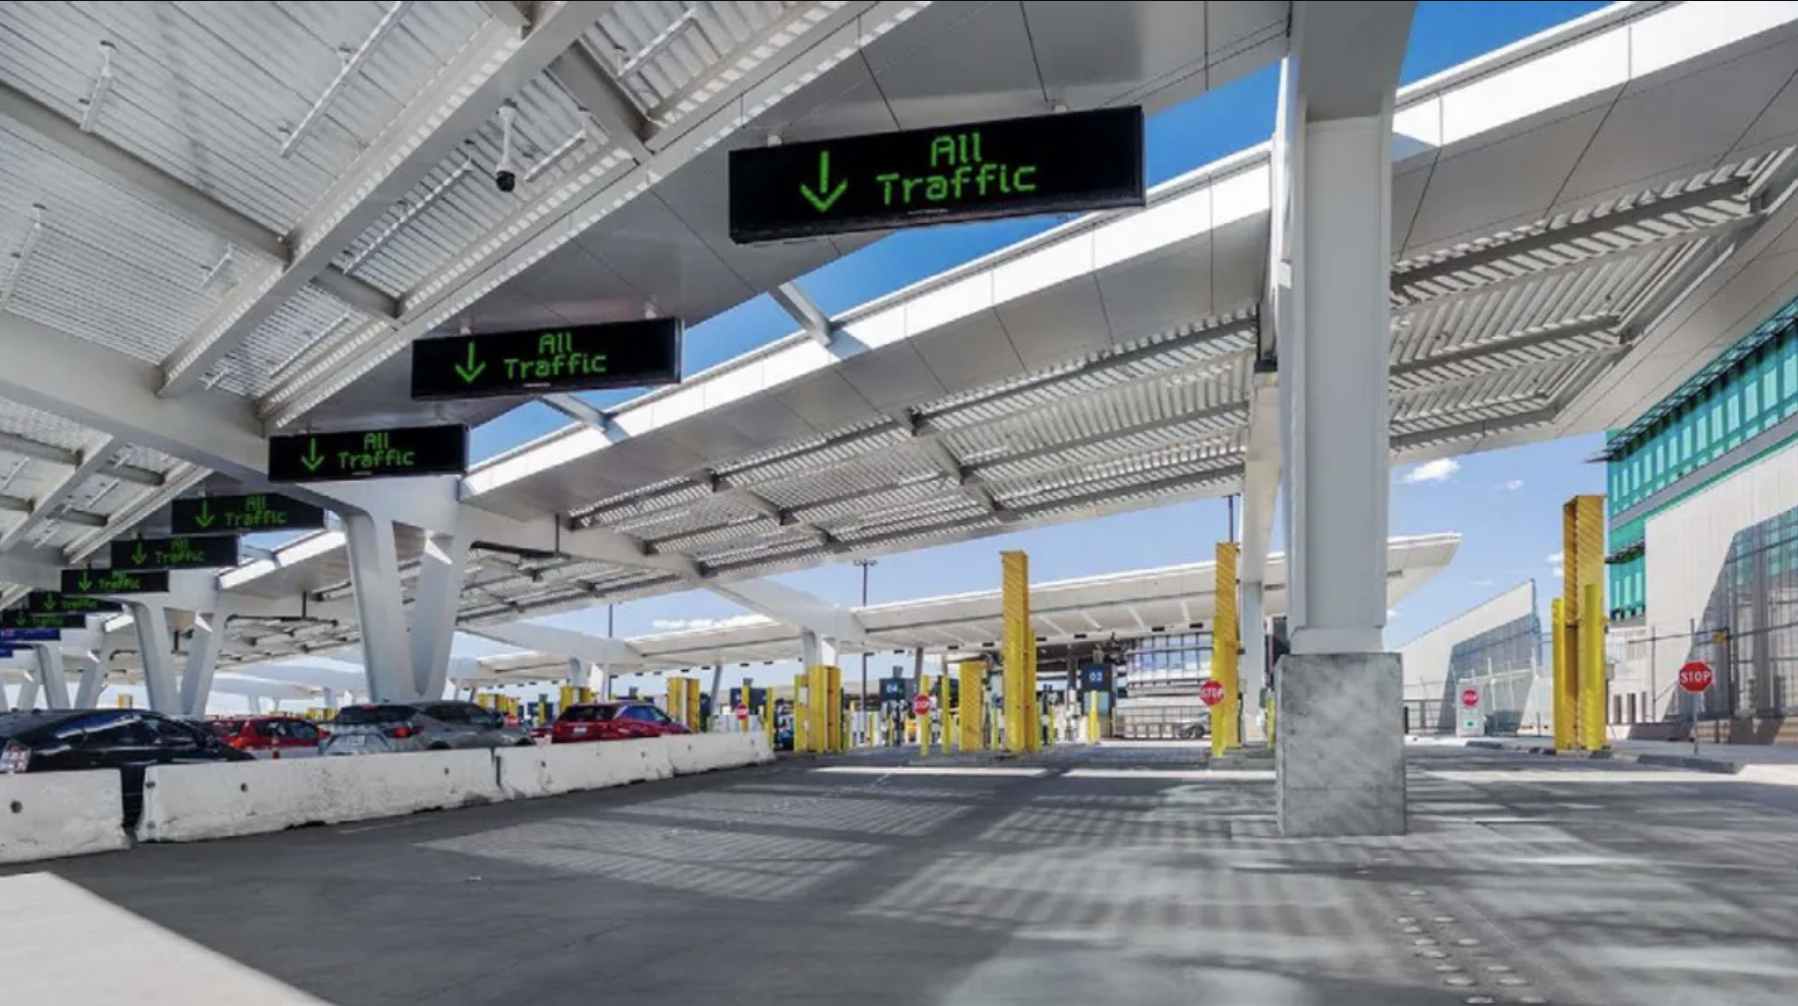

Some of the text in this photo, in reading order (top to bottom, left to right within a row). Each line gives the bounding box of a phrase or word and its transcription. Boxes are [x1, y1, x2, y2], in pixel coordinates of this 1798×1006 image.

[930, 132, 983, 167] All
[876, 163, 1037, 205] Traffic
[538, 332, 573, 355] All
[504, 352, 607, 380] Traffic
[363, 432, 389, 450] All
[337, 449, 416, 469] Traffic
[245, 495, 267, 511] All
[224, 510, 288, 527] Traffic
[155, 549, 205, 563] Traffic
[1681, 670, 1711, 684] STOP
[1200, 686, 1225, 699] STOP
